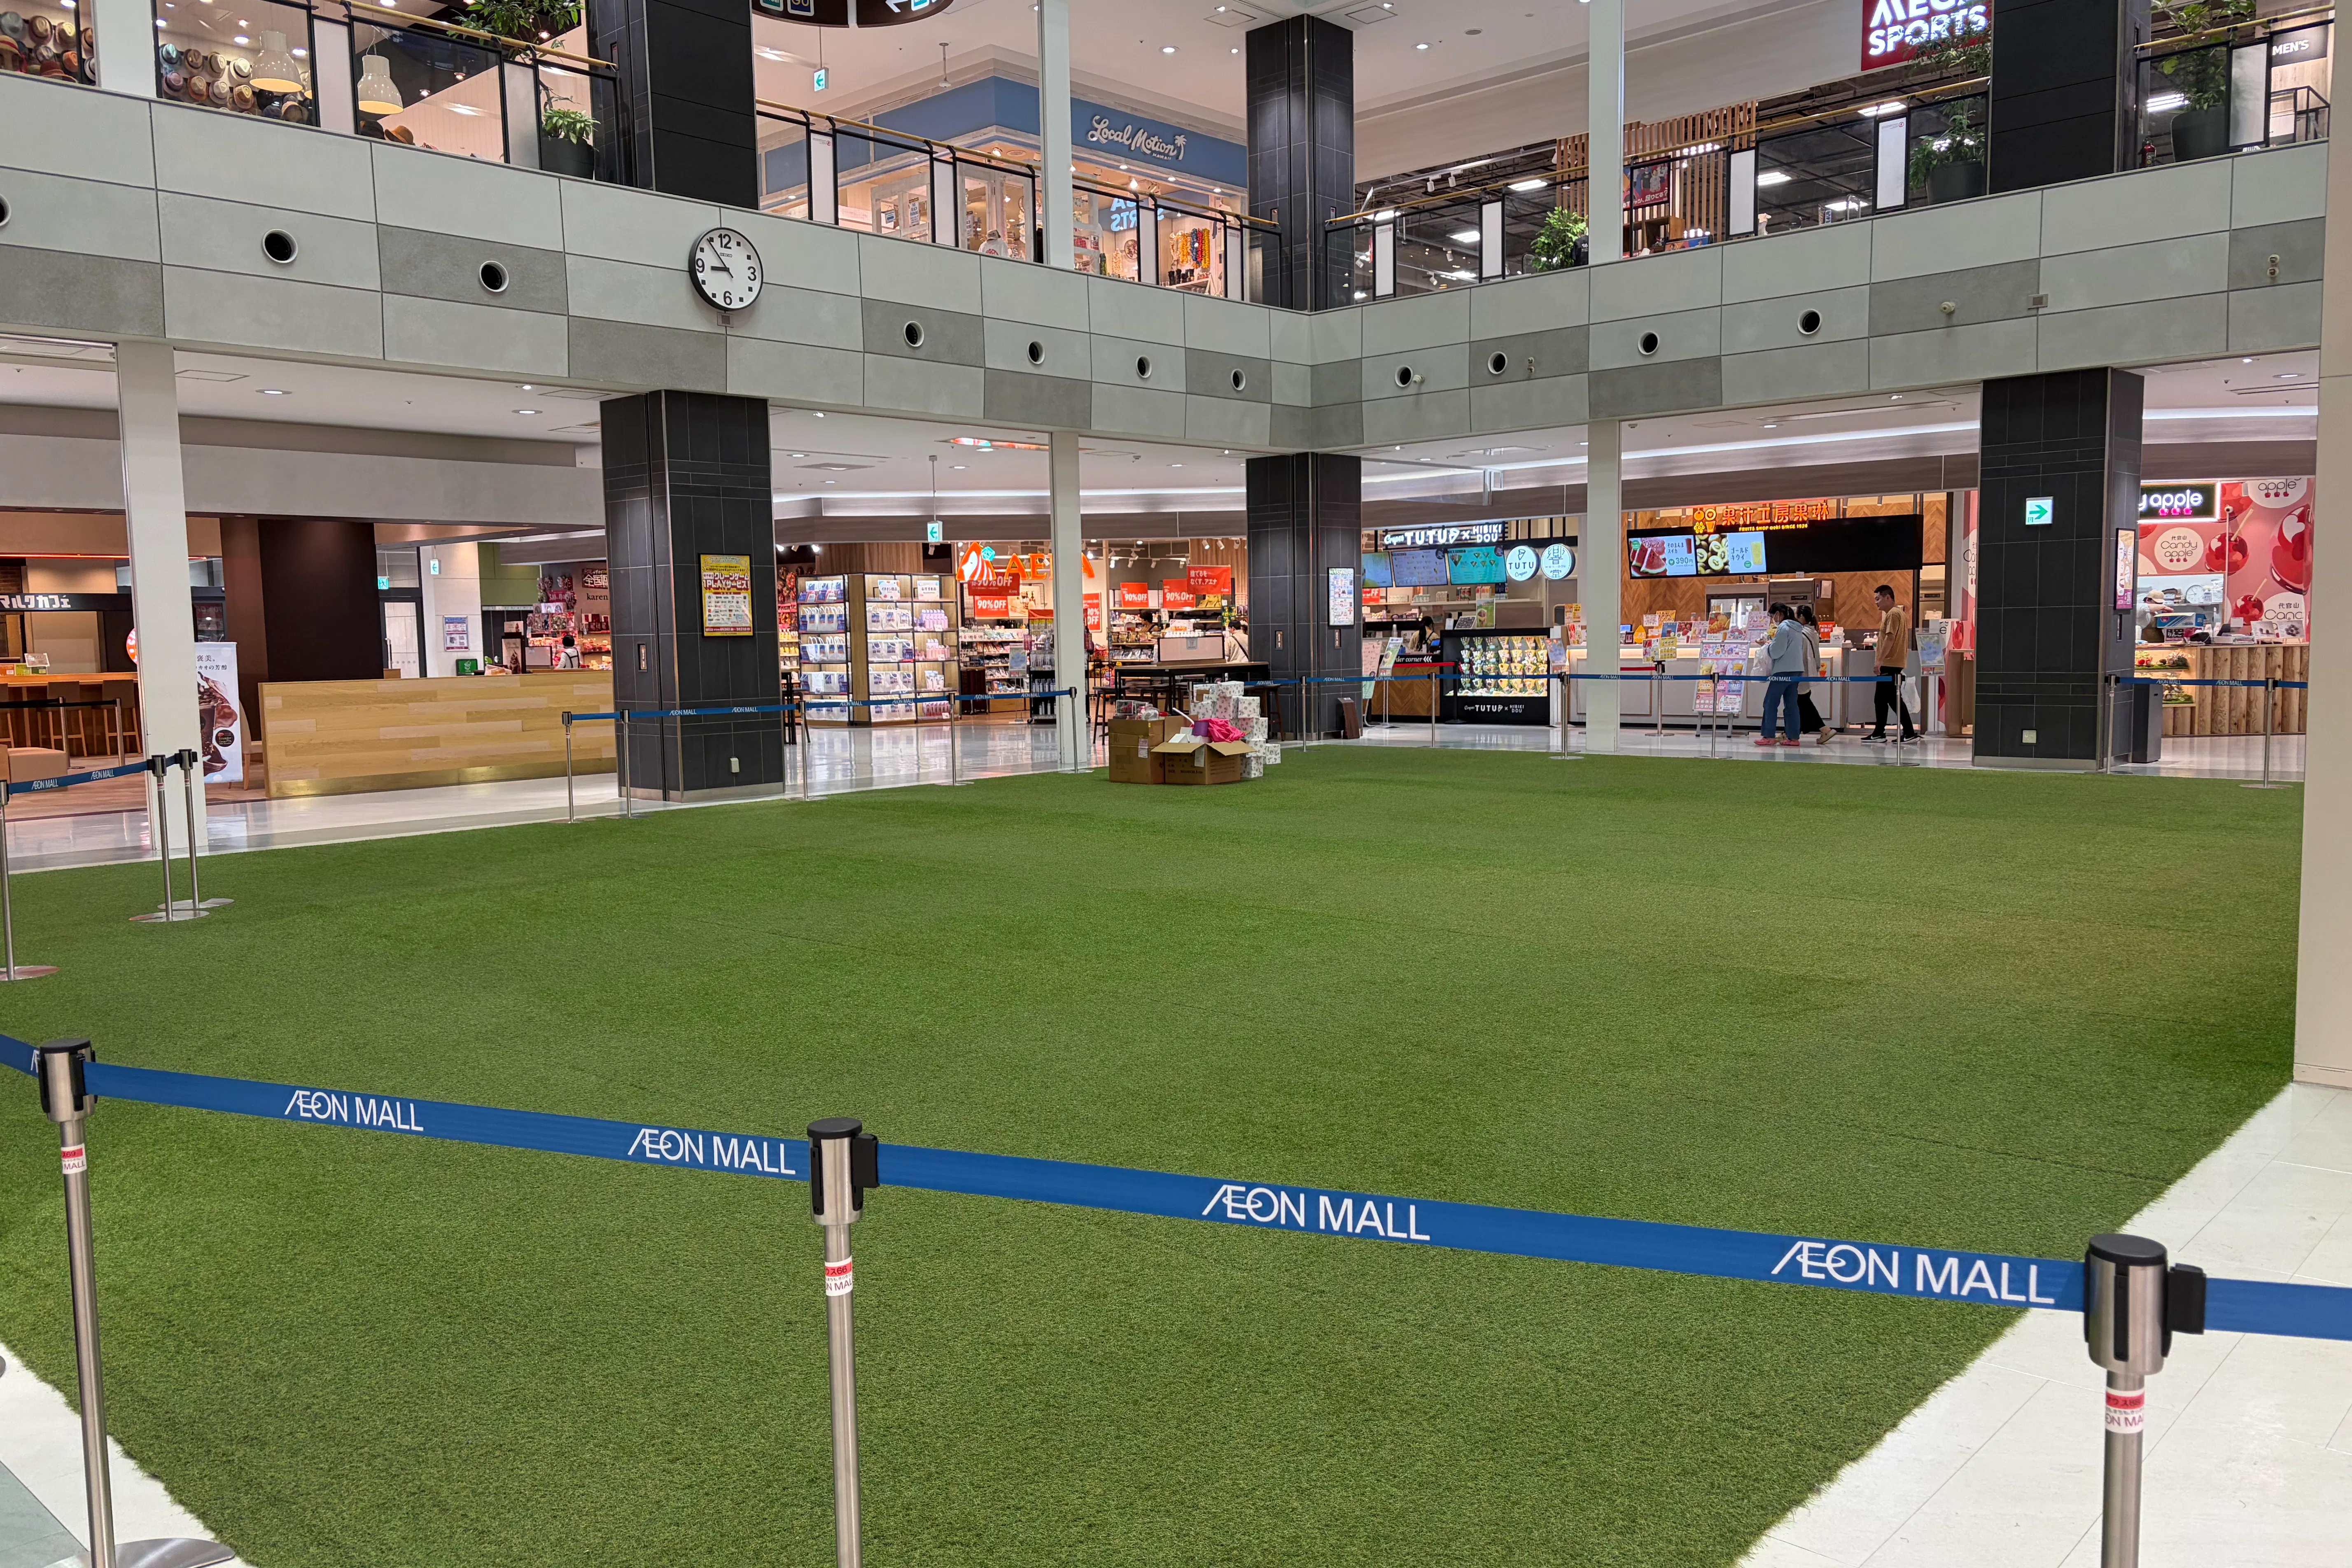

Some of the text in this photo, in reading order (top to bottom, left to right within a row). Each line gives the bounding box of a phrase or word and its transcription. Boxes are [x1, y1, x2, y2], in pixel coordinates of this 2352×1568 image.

[1869, 5, 1987, 56] SPORTS
[2272, 39, 2309, 56] MEN'S
[1088, 115, 1177, 154] Local Motion
[718, 233, 732, 250] 12
[696, 258, 705, 273] 9
[748, 266, 757, 281] 3
[723, 291, 733, 306] 6
[2258, 479, 2296, 493] apple
[2150, 489, 2203, 508] apple
[1722, 502, 1829, 525] 果汁工房果琳
[1405, 530, 1447, 545] TUTU
[1473, 524, 1502, 534] HIBIKI
[1477, 534, 1498, 543] DOU
[2161, 540, 2198, 550] Candy
[2164, 549, 2193, 558] apple
[978, 600, 1006, 609] 90%OFF
[103, 769, 114, 778] MALL
[45, 779, 58, 788] MALL
[356, 1097, 424, 1132] MALL
[713, 1136, 796, 1174] MALL
[64, 1160, 85, 1170] MALL
[1319, 1196, 1430, 1240] MALL
[1916, 1254, 2055, 1304] MALL
